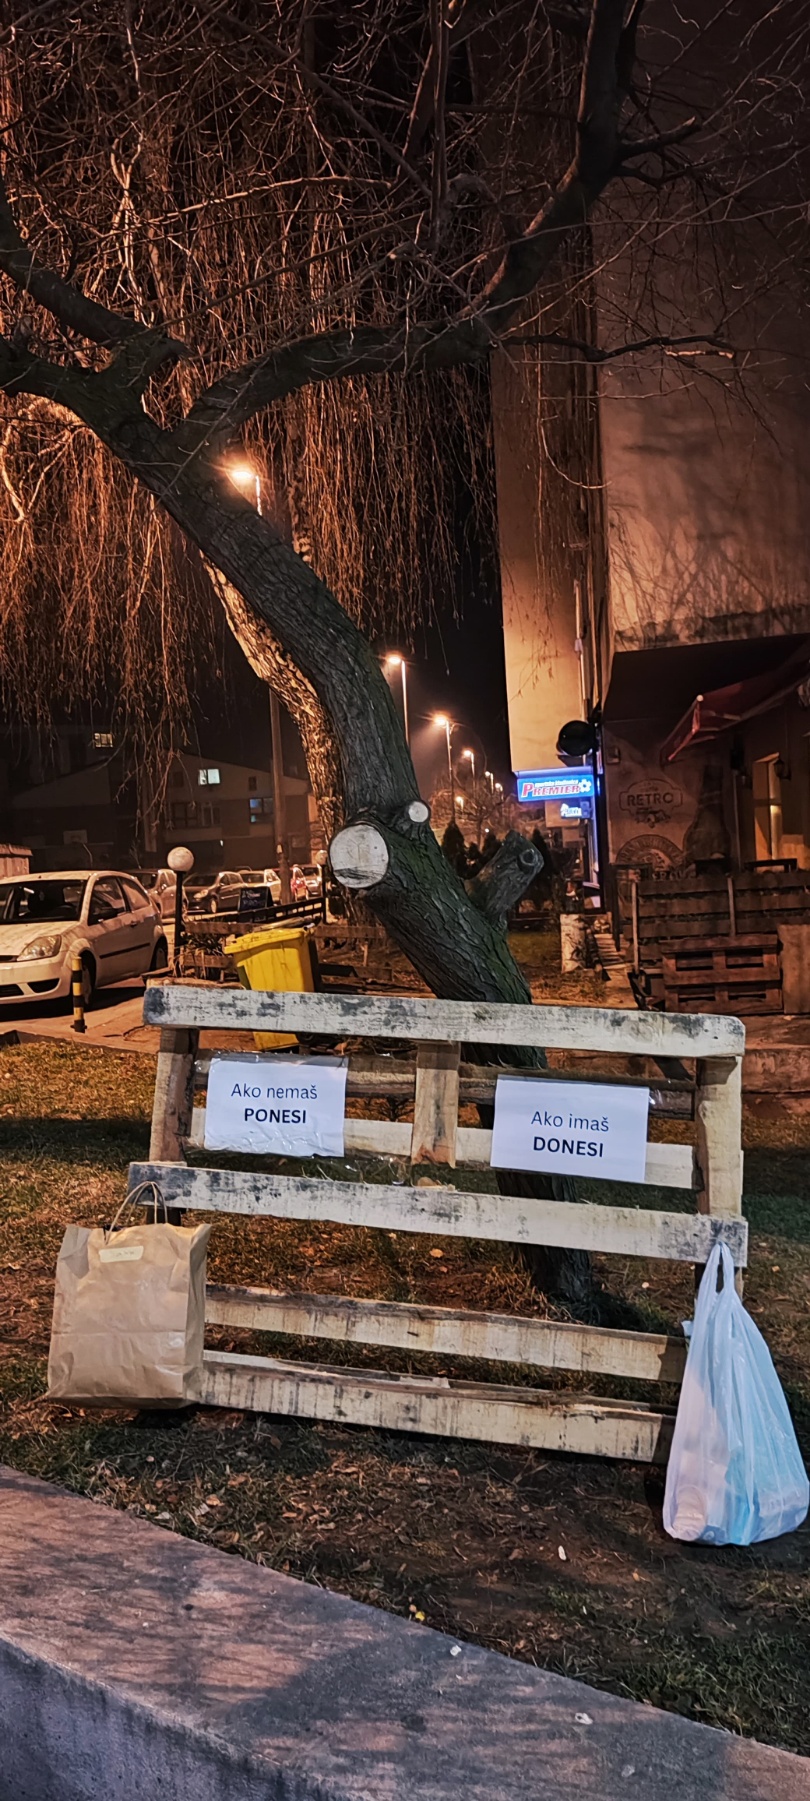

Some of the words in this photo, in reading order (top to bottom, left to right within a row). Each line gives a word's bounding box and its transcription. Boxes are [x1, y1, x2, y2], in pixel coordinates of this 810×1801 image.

[521, 783, 581, 797] PREMIER
[627, 792, 674, 806] RETRO
[230, 1083, 262, 1098] Ako
[266, 1084, 318, 1100] nemaš
[244, 1107, 307, 1124] PONESI
[530, 1110, 563, 1128] Ako
[568, 1113, 609, 1132] imaš
[533, 1136, 604, 1158] DONESI
